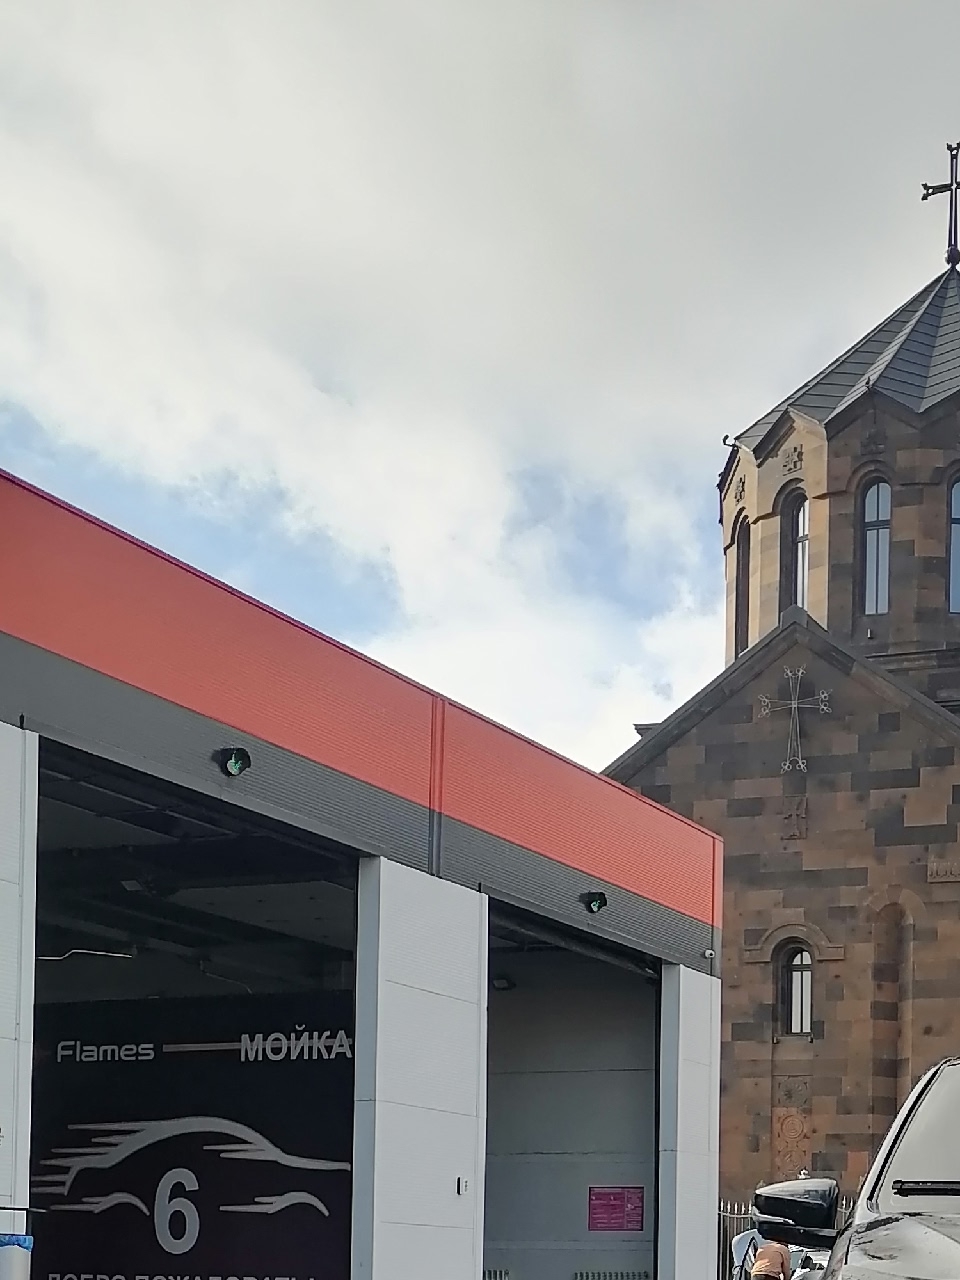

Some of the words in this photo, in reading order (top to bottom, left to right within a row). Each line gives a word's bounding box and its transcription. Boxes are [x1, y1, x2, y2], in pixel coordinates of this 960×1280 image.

[56, 1040, 155, 1063] Flames
[239, 1024, 353, 1062] МОЙКА
[153, 1167, 200, 1255] 6
